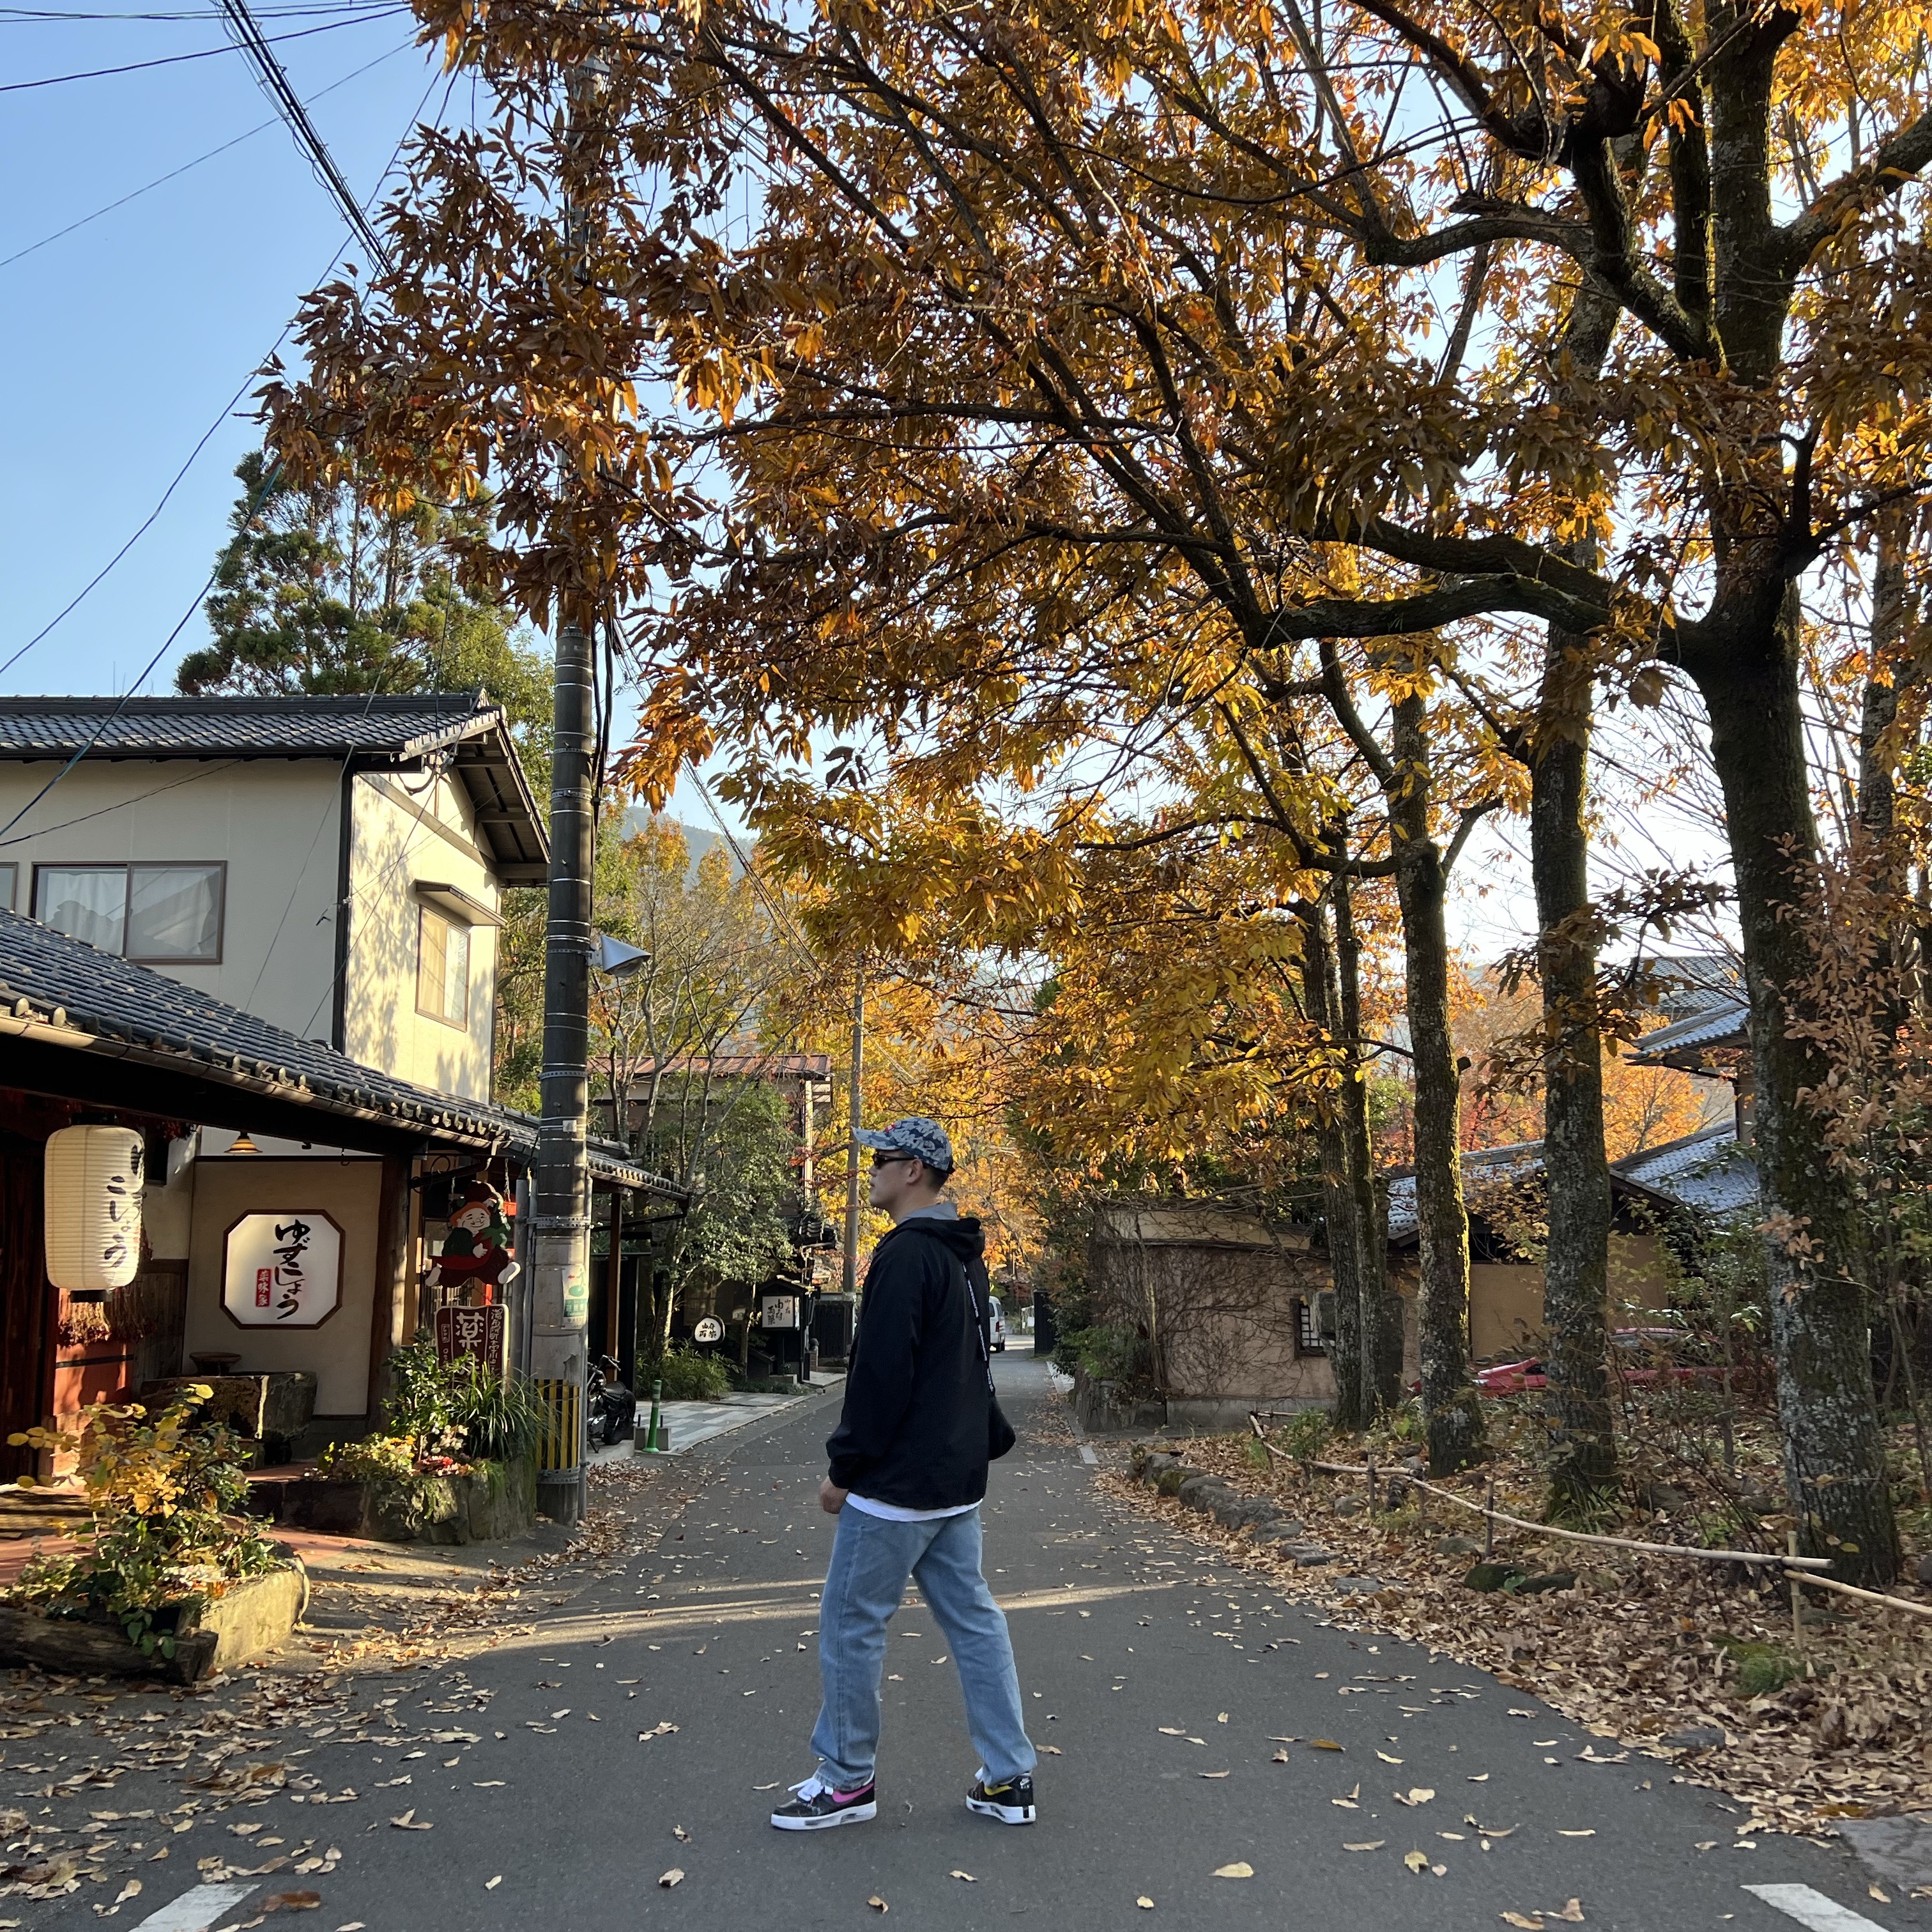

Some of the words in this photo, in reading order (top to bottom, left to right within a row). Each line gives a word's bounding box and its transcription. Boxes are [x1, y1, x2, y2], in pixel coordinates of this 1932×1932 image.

[273, 1219, 310, 1320] ゆずこしょう
